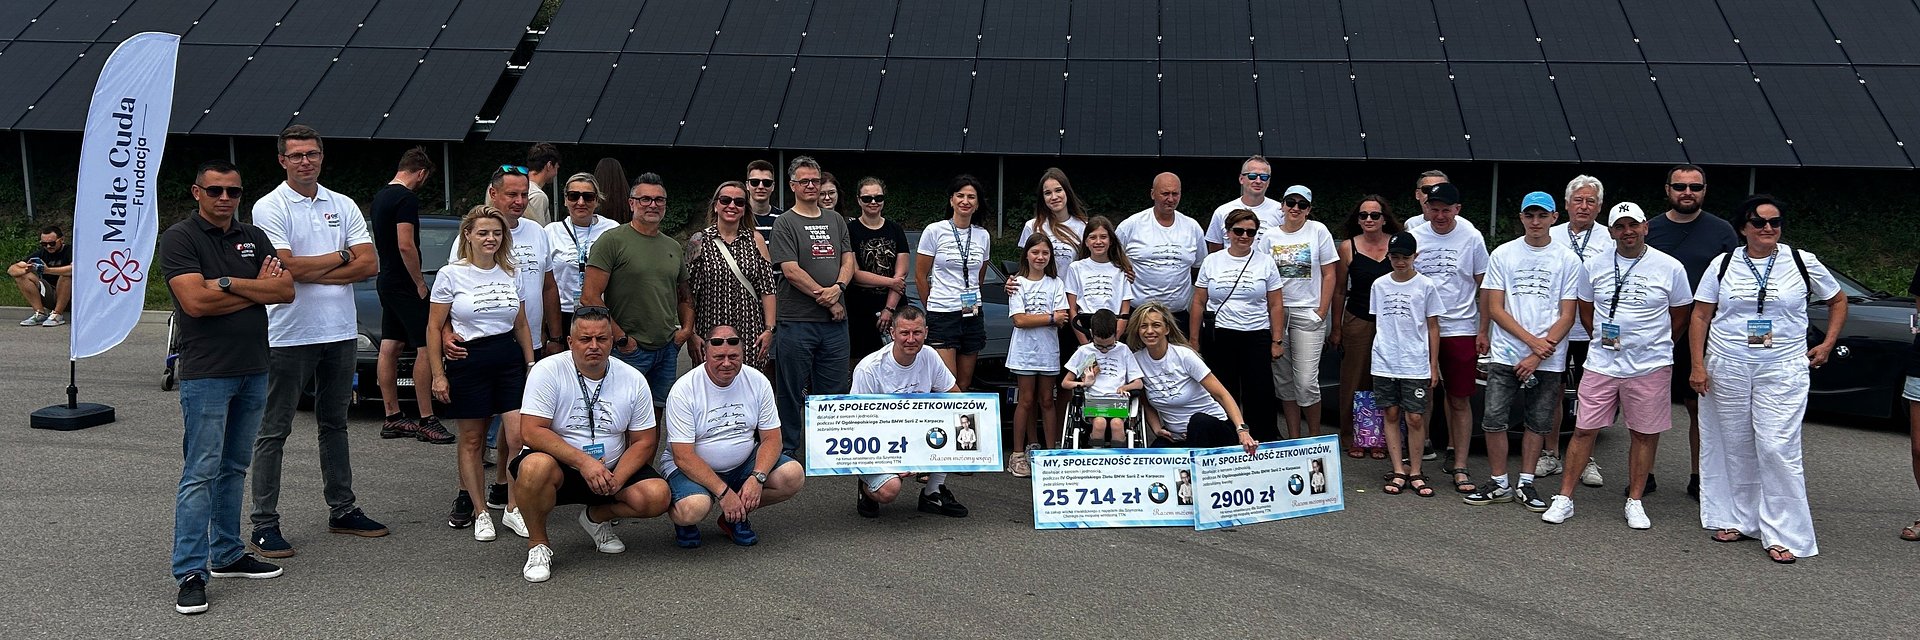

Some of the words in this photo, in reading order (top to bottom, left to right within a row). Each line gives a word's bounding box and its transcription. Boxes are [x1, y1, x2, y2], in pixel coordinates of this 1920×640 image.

[109, 97, 136, 168] Cuda
[133, 137, 150, 205] Fundacja
[102, 177, 128, 242] Małe
[1618, 204, 1630, 213] NY
[818, 403, 837, 413] MY,
[839, 400, 910, 411] SPOŁECZNOŚĆ
[912, 400, 988, 411] ZETKOWICZÓW,
[825, 436, 881, 455] 2900
[888, 436, 908, 453] zł
[1202, 458, 1218, 467] MY,
[1218, 450, 1274, 465] SPOŁECZNOŚĆ
[1275, 444, 1332, 459] ZETKOWICZÓW,
[1043, 459, 1061, 468] MY,
[1062, 455, 1131, 467] SPOŁECZNOŚĆ
[1042, 489, 1070, 506] 25
[1075, 487, 1116, 505] 714
[1121, 487, 1142, 504] zł
[1210, 488, 1255, 510] 2900
[1259, 485, 1276, 503] zł
